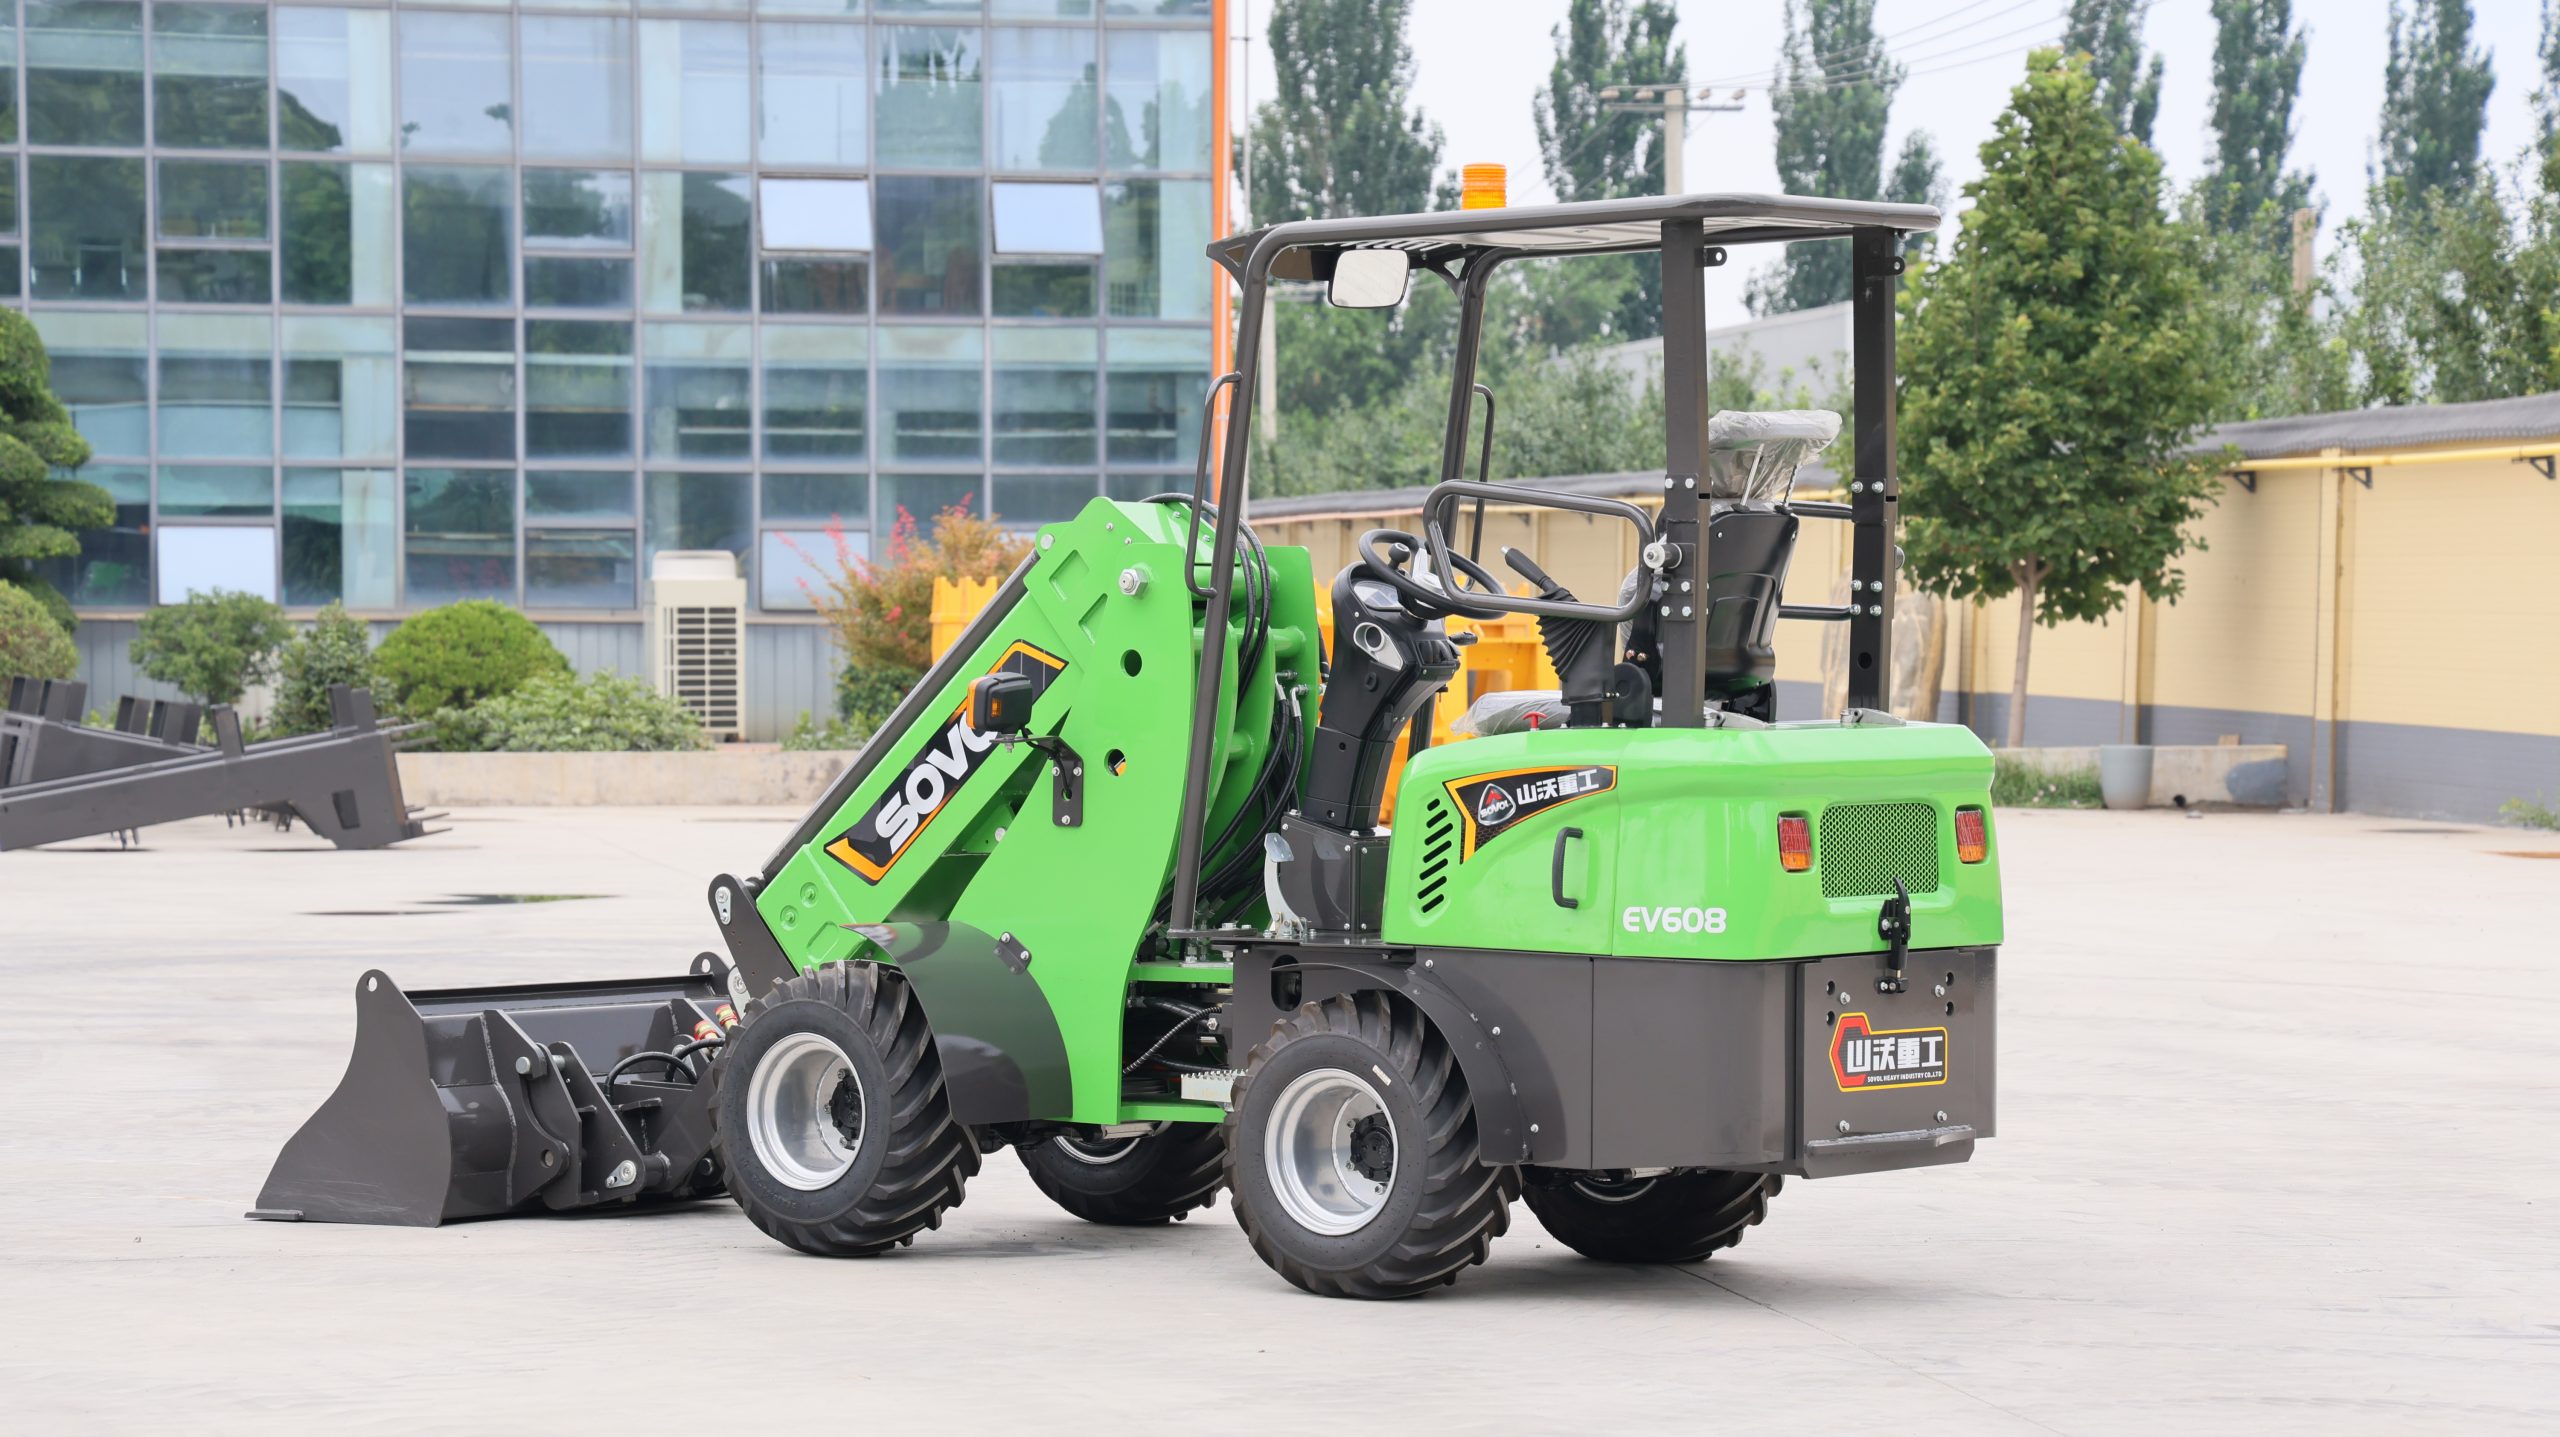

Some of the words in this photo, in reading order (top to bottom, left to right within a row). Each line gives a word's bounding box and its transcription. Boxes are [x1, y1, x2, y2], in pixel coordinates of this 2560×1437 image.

[1516, 768, 1600, 805] 山沃重工
[1480, 800, 1508, 818] SOVOL
[1622, 906, 1727, 934] EV608
[1847, 1035, 1943, 1073] 山沃重工
[1867, 1074, 1884, 1083] SOVOL
[1900, 1072, 1924, 1080] INDUSTRY
